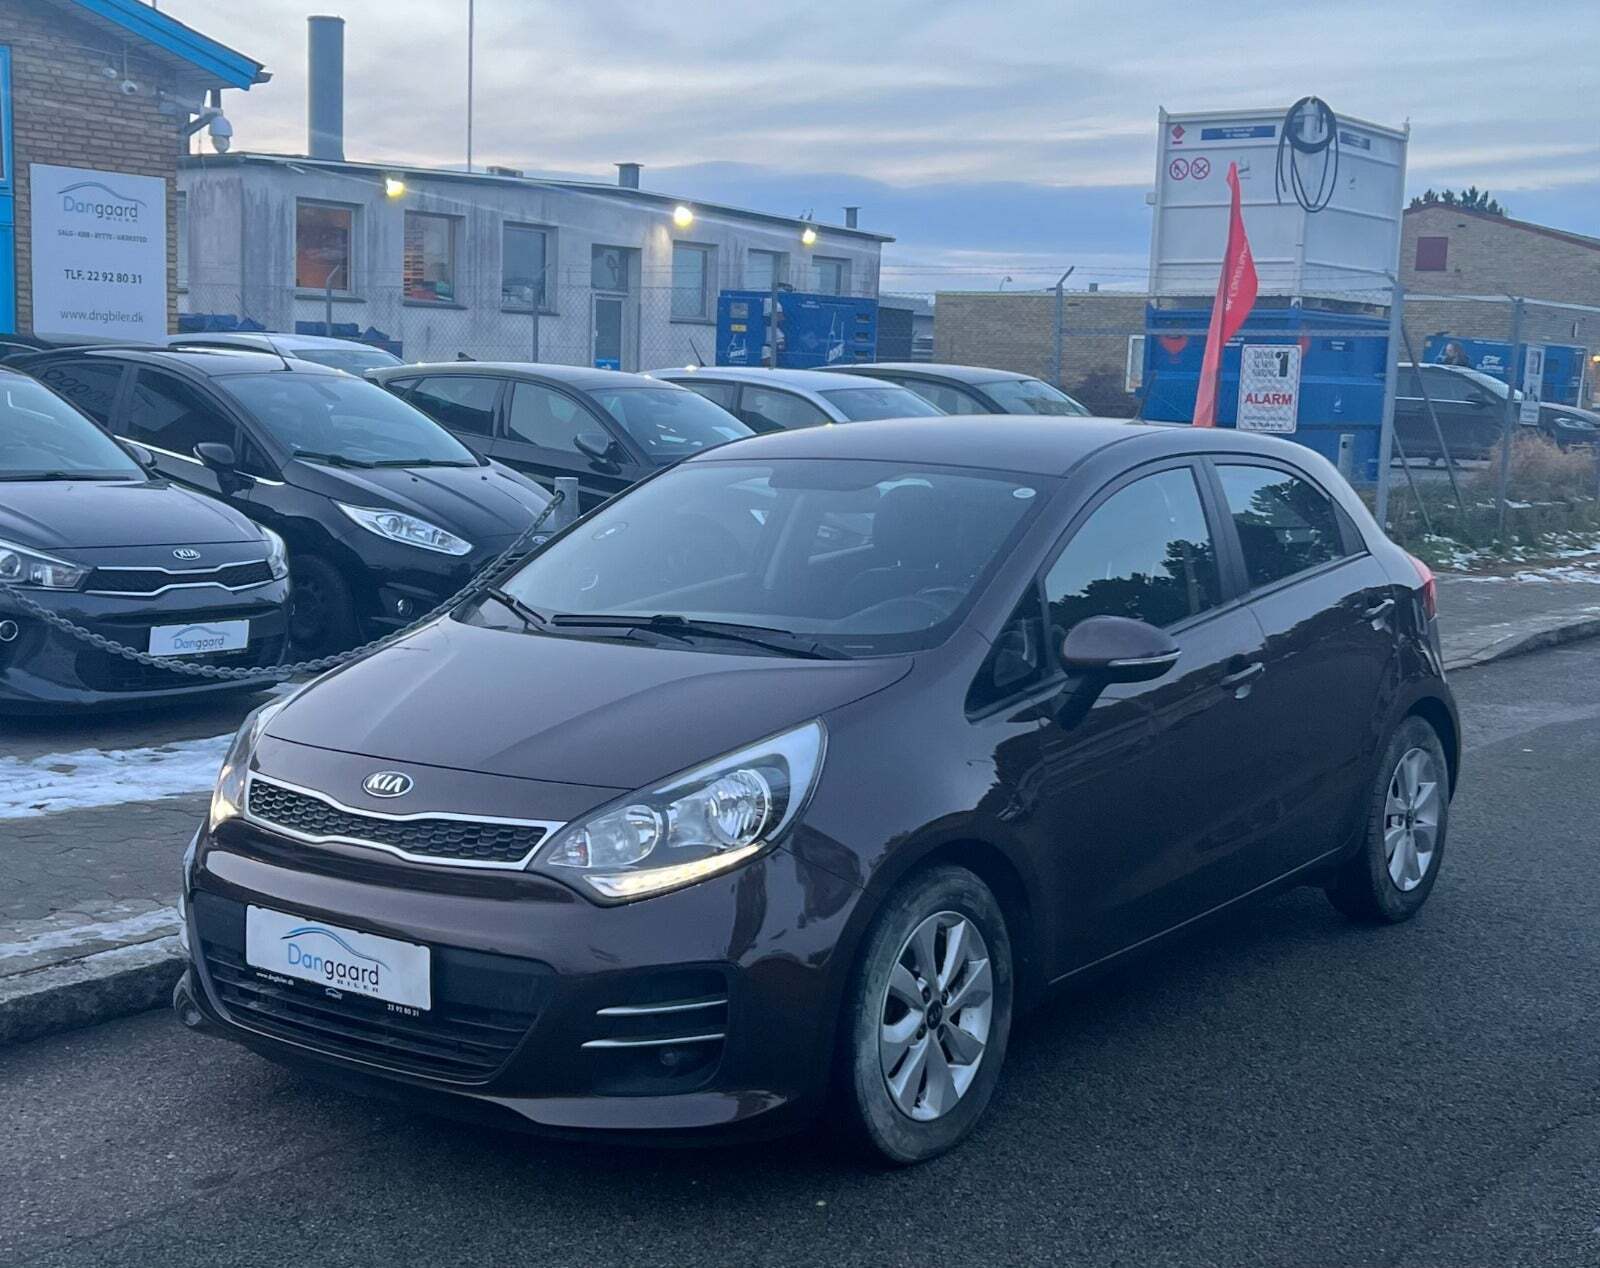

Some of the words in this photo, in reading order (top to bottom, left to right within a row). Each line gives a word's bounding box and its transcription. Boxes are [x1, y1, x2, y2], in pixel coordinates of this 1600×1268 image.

[63, 196, 138, 219] Dangaard
[64, 269, 85, 280] TLF.
[87, 270, 100, 281] 22
[101, 272, 114, 283] 92
[116, 273, 129, 284] 80
[131, 274, 142, 284] 31
[61, 310, 144, 324] www.dngbiler.dk
[1244, 393, 1292, 405] ALARM
[174, 635, 224, 650] Dangaard
[366, 772, 404, 793] KIA
[288, 943, 379, 985] Dangaard
